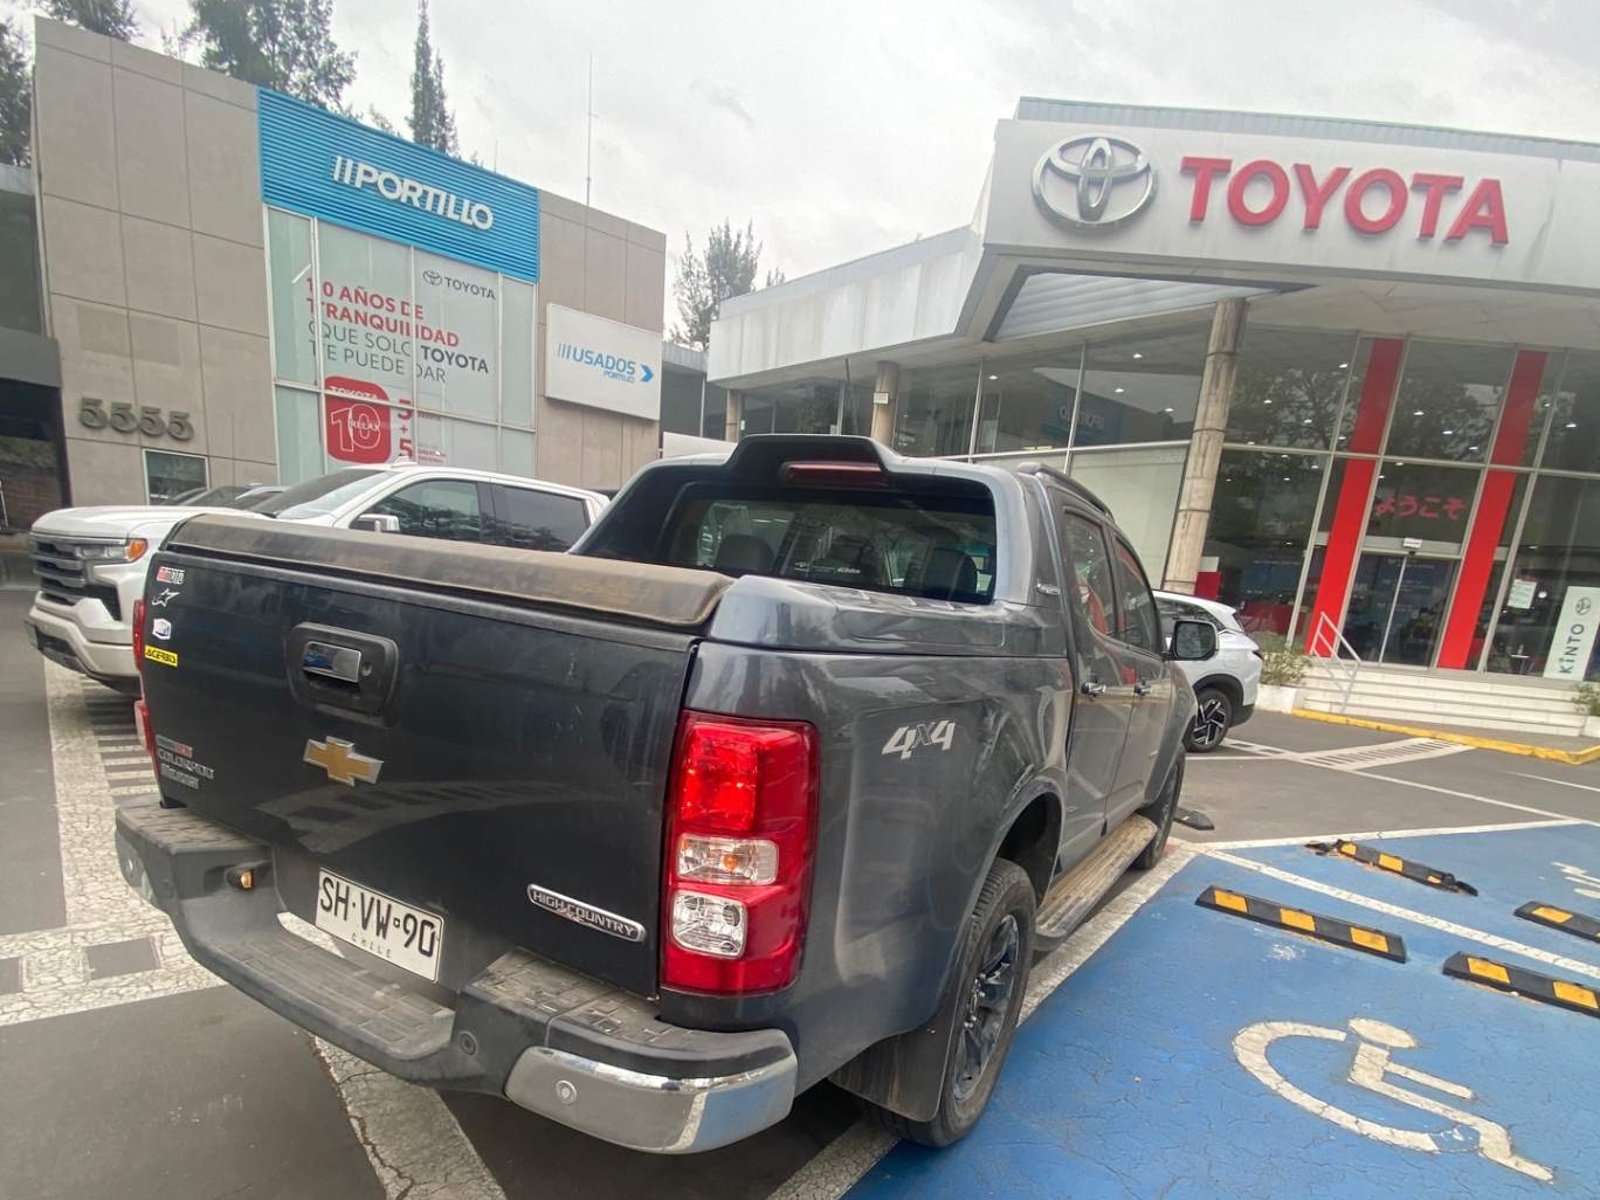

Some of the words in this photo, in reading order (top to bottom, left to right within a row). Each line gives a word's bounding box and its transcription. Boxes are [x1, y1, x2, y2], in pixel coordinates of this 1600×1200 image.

[354, 161, 495, 231] PORTILLO
[1180, 155, 1510, 246] TOYOTA
[339, 285, 396, 313] AÑOS
[401, 301, 424, 320] DE
[443, 275, 496, 300] TOYOTA
[307, 298, 460, 347] TRANQUILIDAD
[308, 320, 358, 345] QUE
[421, 345, 489, 374] TOYOTA
[308, 339, 337, 361] TE
[344, 346, 405, 375] PUEDE
[573, 346, 636, 375] USADOS
[79, 397, 194, 442] 5555
[331, 403, 381, 453] 10
[1374, 492, 1465, 520] ようこそ
[1558, 623, 1585, 674] KINTO
[532, 889, 565, 910] HIGH
[567, 904, 636, 937] COUNTRY
[351, 932, 392, 958] CHILE
